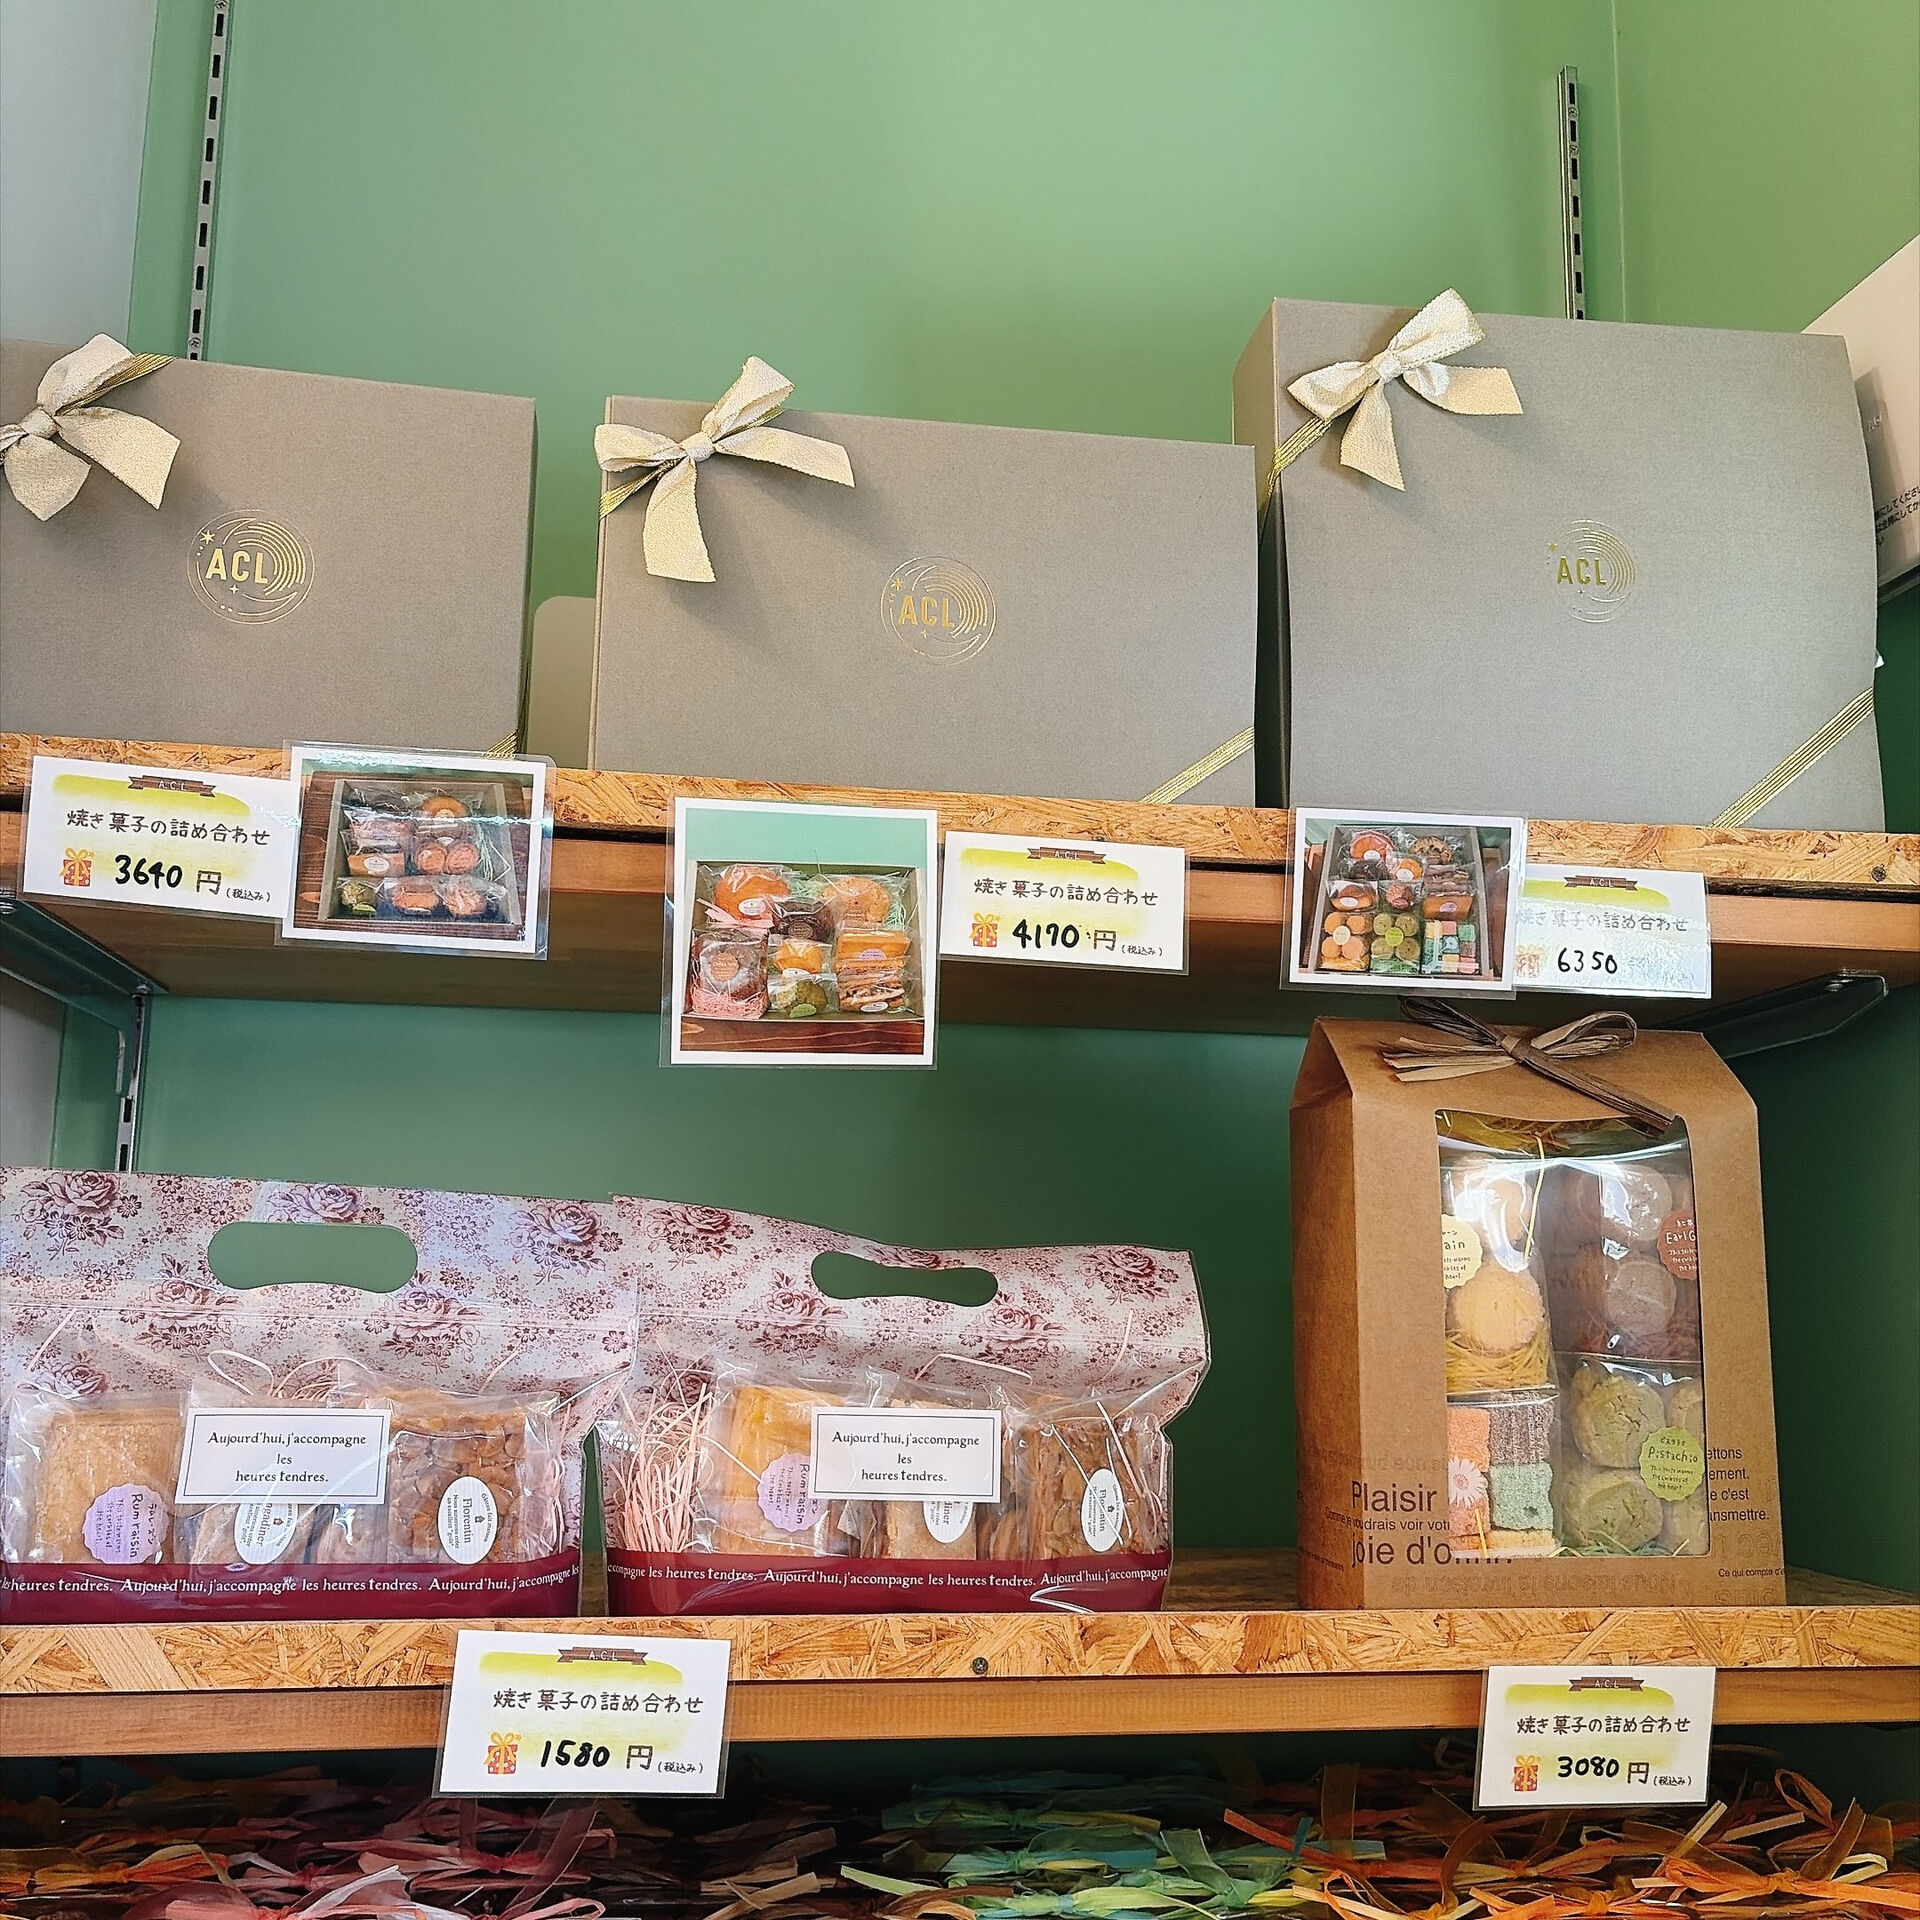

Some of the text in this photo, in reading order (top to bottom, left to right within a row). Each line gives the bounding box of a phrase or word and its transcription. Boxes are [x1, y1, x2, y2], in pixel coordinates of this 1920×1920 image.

[205, 548, 269, 584] ACL
[1557, 555, 1607, 585] ACL
[899, 595, 955, 627] ACL
[67, 808, 271, 846] 焼き菓子の詰め合わせ
[114, 854, 183, 889] 3640
[196, 869, 222, 895] 円
[974, 877, 1159, 906] 焼き菓子の詰め合わせ
[1012, 918, 1080, 949] 4170
[1093, 929, 1117, 951] 円
[1557, 946, 1618, 974] 6350
[207, 1432, 367, 1448] Aujourd'hui, j'accompagne
[832, 1431, 980, 1448] Aujourd'hui, j'accompagne
[277, 1453, 293, 1465] les
[897, 1453, 912, 1464] les
[235, 1470, 329, 1483] heures tendres.
[861, 1469, 948, 1482] heures tendres.
[796, 1463, 810, 1524] Rum raisin
[1351, 1480, 1437, 1513] Plaisir
[1721, 1488, 1750, 1501] c'est
[462, 1498, 474, 1544] Florentin
[1099, 1489, 1107, 1532] Flontin
[1400, 1518, 1424, 1531] voir
[129, 1493, 144, 1558] Rum raisin
[1352, 1532, 1395, 1568] joie
[11, 1578, 56, 1591] heures
[58, 1578, 113, 1591] tendres.
[302, 1578, 319, 1591] les
[322, 1578, 366, 1591] heures
[368, 1579, 422, 1591] tendres.
[649, 1565, 663, 1578] les
[665, 1566, 706, 1580] heures
[707, 1567, 757, 1581] tendres.
[843, 1571, 924, 1589] j'accompagne
[928, 1573, 944, 1586] les
[947, 1573, 987, 1586] heures
[989, 1573, 1036, 1587] tendres.
[1040, 1569, 1105, 1586] Aujourd'hui,
[493, 1688, 704, 1715] 焼き菓子の詰め合わせ
[1516, 1715, 1691, 1735] 焼き菓子の詰め合わせ
[540, 1739, 610, 1768] 1580
[626, 1745, 653, 1770] 円
[1556, 1755, 1620, 1778] 3080
[1627, 1762, 1650, 1785] 円
